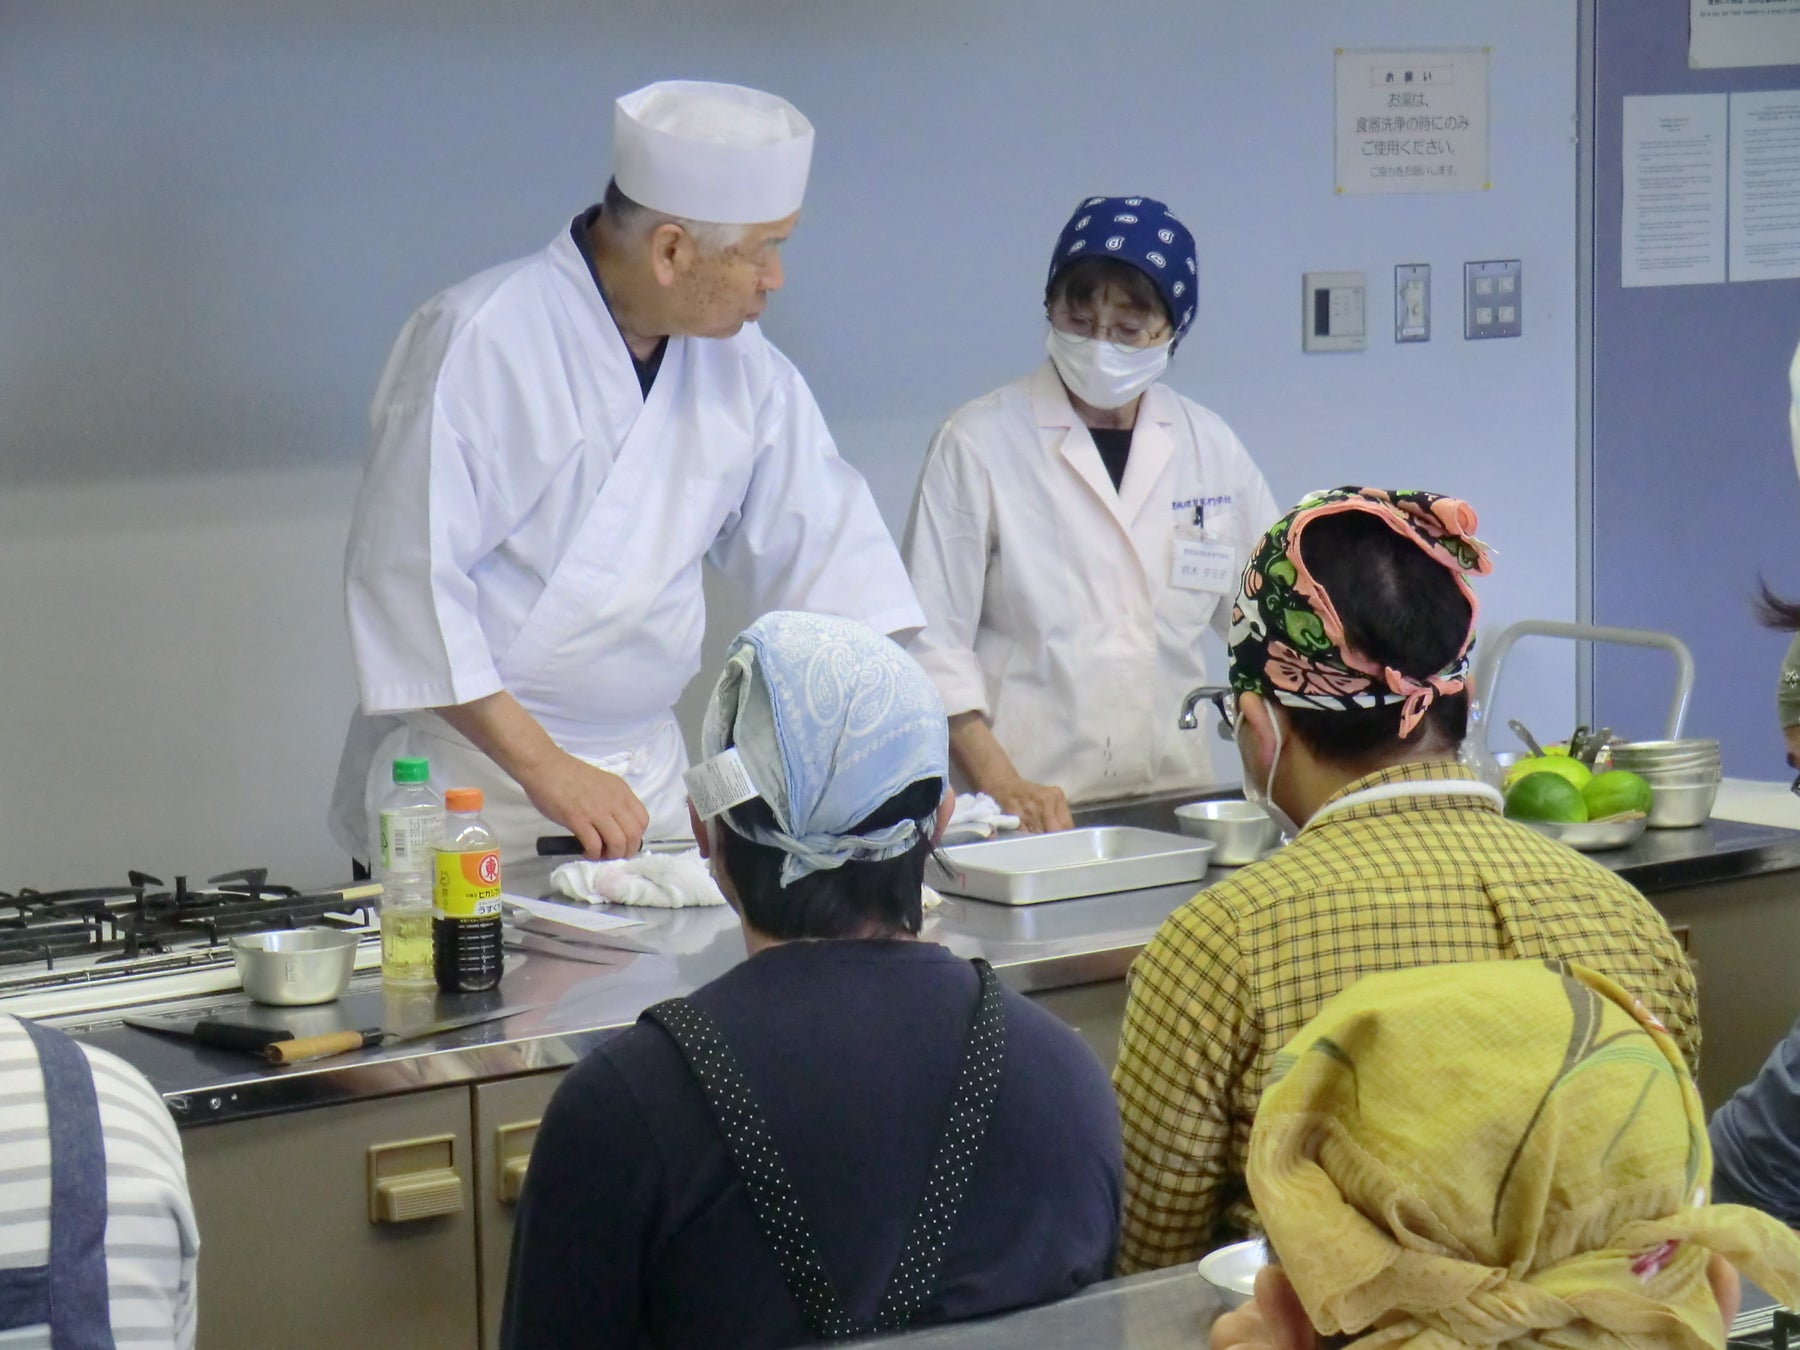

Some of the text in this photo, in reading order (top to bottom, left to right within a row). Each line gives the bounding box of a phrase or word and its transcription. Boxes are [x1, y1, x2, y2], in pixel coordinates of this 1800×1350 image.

[1356, 116, 1470, 133] 食器洗浄の時にのみ
